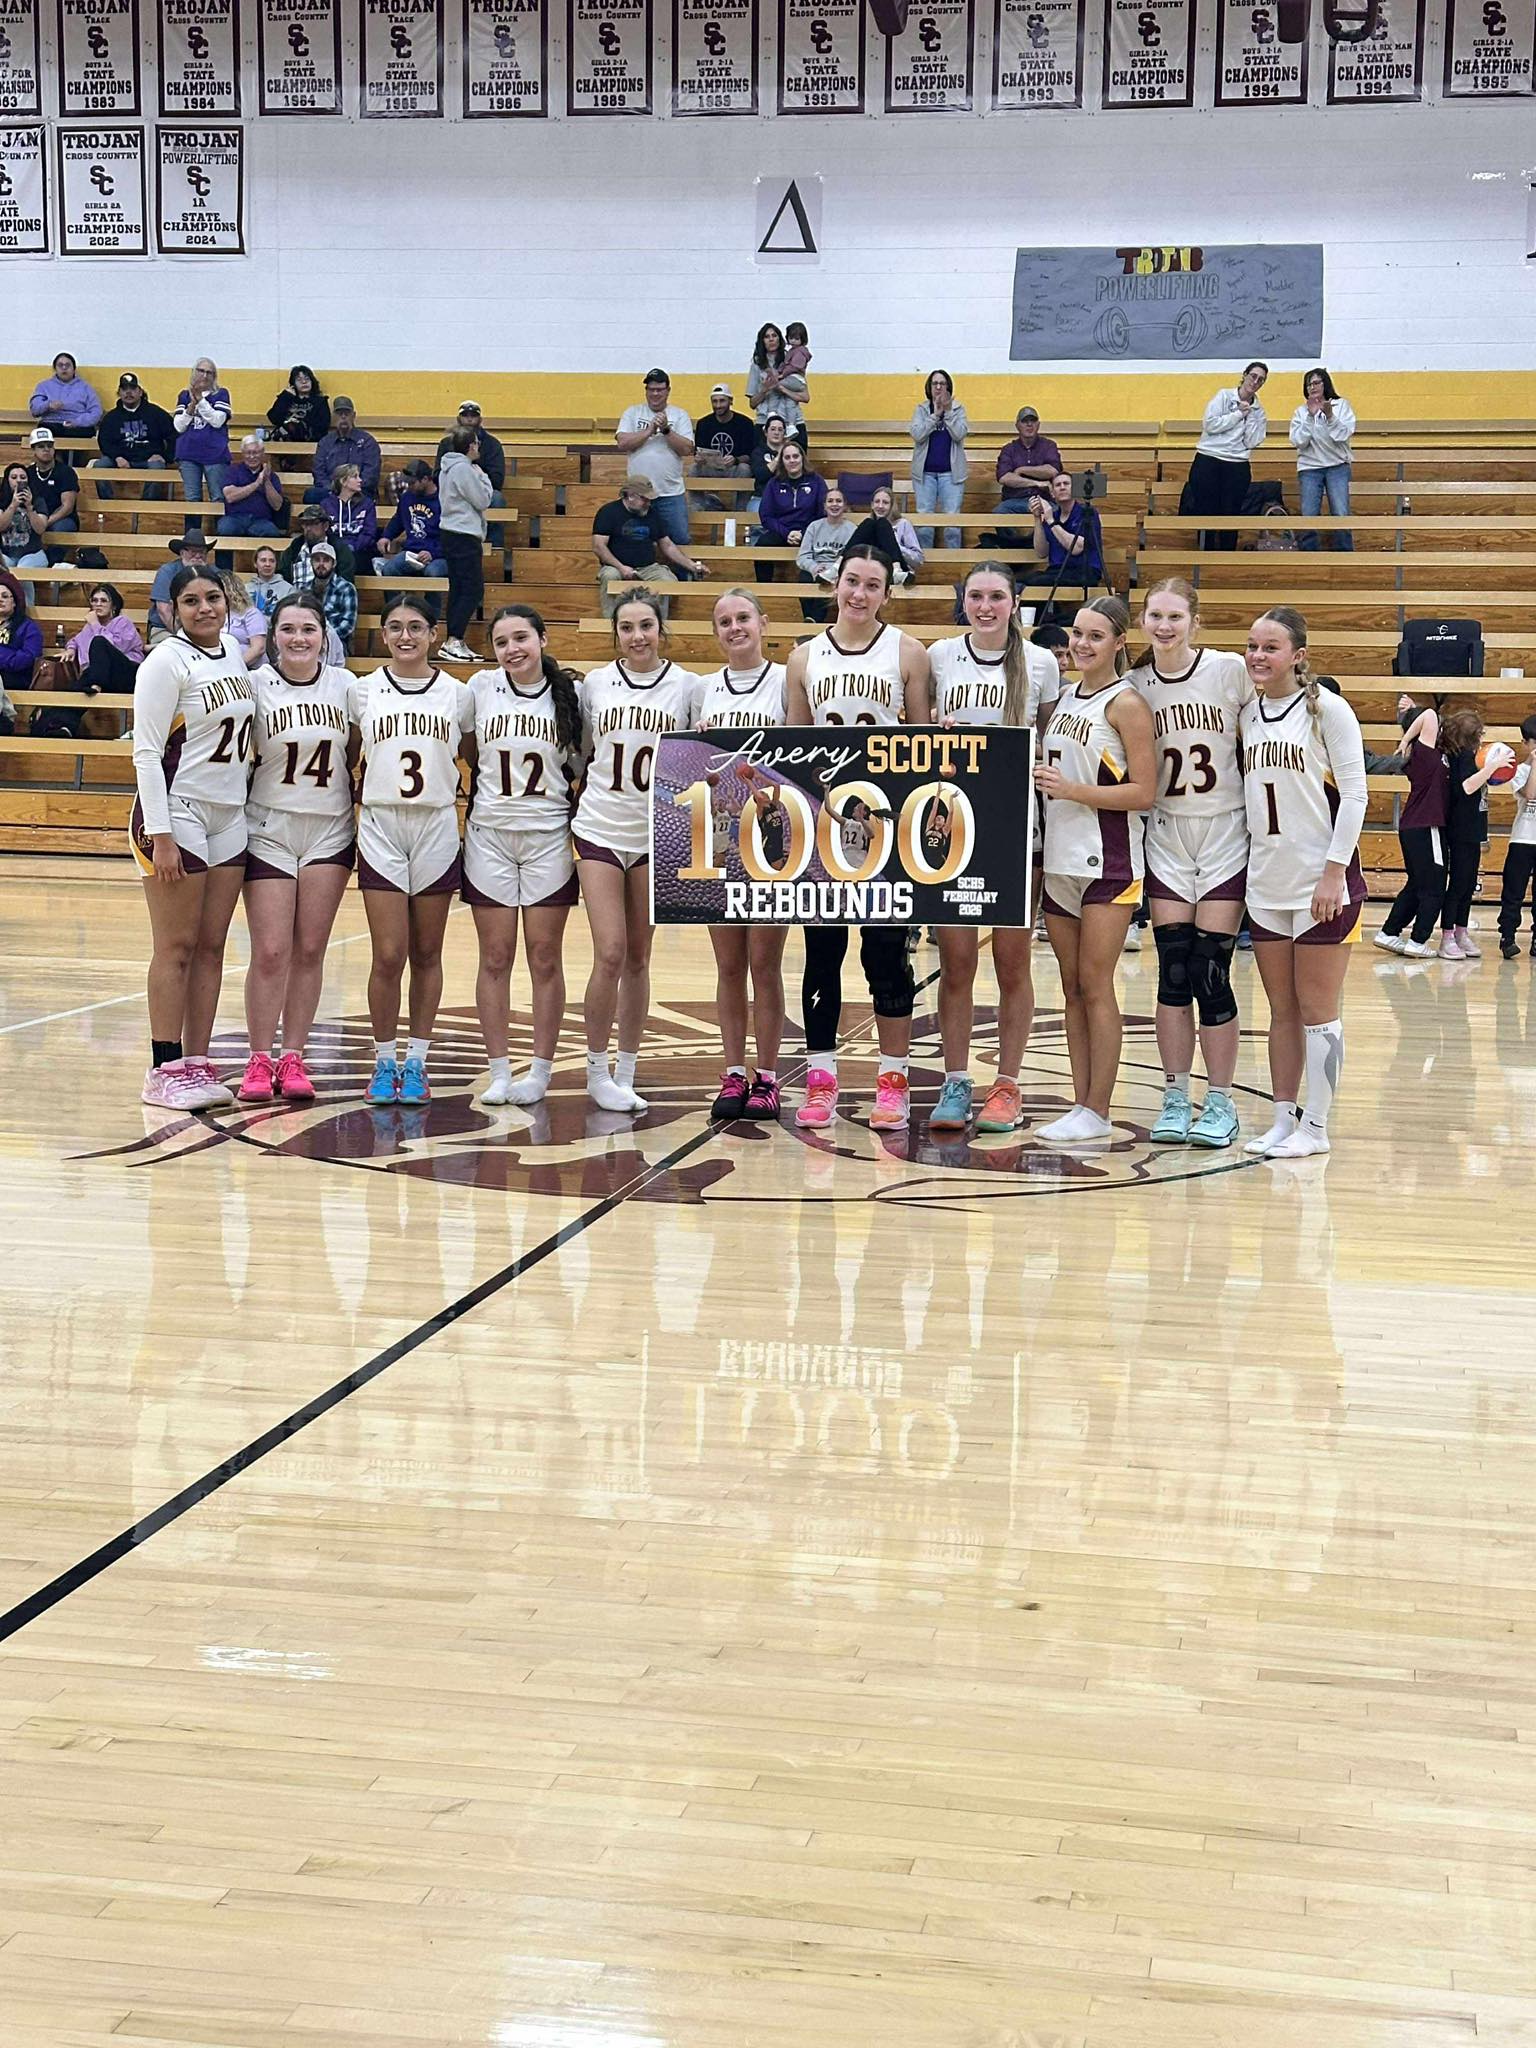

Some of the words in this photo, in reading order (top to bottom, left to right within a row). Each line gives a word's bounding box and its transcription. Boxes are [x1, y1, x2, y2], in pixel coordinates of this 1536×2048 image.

[65, 0, 130, 14] TROJAN
[165, 0, 231, 14] TROJAN
[369, 0, 435, 13] TROJAN
[473, 0, 538, 13] TROJAN
[927, 6, 963, 14] COUNTRY
[1005, 3, 1031, 11] CROSS
[1034, 2, 1072, 11] COUNTRY
[85, 16, 111, 24] TRACK
[167, 16, 193, 24] CROSS
[195, 16, 228, 24] COUNTRY
[267, 13, 293, 21] CROSS
[295, 13, 328, 21] COUNTRY
[388, 15, 415, 23] TRACK
[492, 14, 518, 23] TRACK
[578, 11, 603, 20] CROSS
[606, 11, 641, 19] COUNTRY
[683, 11, 708, 20] CROSS
[711, 11, 747, 19] COUNTRY
[789, 9, 815, 18] CROSS
[818, 9, 855, 17] COUNTRY
[1357, 53, 1393, 63] STATE
[1475, 47, 1511, 58] STATE
[1020, 60, 1055, 70] STATE
[1131, 58, 1166, 68] STATE
[1244, 55, 1280, 66] STATE
[1454, 59, 1530, 75] CHAMPIONS
[83, 70, 115, 79] STATE
[184, 70, 215, 80] STATE
[283, 68, 315, 77] STATE
[385, 70, 418, 80] STATE
[489, 70, 521, 79] STATE
[593, 67, 626, 77] STATE
[699, 67, 731, 77] STATE
[804, 65, 838, 75] STATE
[912, 64, 947, 73] STATE
[1225, 67, 1299, 83] CHAMPIONS
[1337, 64, 1412, 80] CHAMPIONS
[895, 75, 965, 90] CHAMPIONS
[1001, 71, 1073, 87] CHAMPIONS
[1112, 69, 1184, 86] CHAMPIONS
[67, 81, 132, 95] CHAMPIONS
[166, 81, 232, 96] CHAMPIONS
[267, 79, 333, 93] CHAMPIONS
[368, 81, 435, 96] CHAMPIONS
[472, 81, 539, 96] CHAMPIONS
[576, 78, 644, 93] CHAMPIONS
[681, 78, 749, 94] CHAMPIONS
[786, 77, 856, 92] CHAMPIONS
[1244, 84, 1280, 97] 1994
[1356, 82, 1392, 95] 1994
[912, 92, 946, 104] 1992
[1020, 88, 1054, 101] 1993
[1130, 87, 1165, 99] 1994
[84, 97, 116, 108] 1983
[183, 97, 215, 109] 1984
[489, 97, 521, 109] 1986
[593, 95, 626, 107] 1989
[63, 134, 140, 149] TROJAN
[161, 133, 238, 148] TROJAN
[65, 152, 94, 160] CROSS
[96, 152, 139, 160] COUNTRY
[163, 153, 238, 165] POWERLIFTING
[90, 165, 114, 196] SC
[187, 166, 210, 196] SC
[193, 198, 206, 207] 1A
[83, 213, 124, 222] STATE
[181, 213, 221, 221] STATE
[67, 225, 141, 234] CHAMPIONS
[163, 222, 236, 232] CHAMPIONS
[89, 237, 119, 246] 2022
[186, 235, 216, 245] 2024
[1096, 273, 1220, 302] POWERLIFTING
[201, 679, 229, 715] LADY
[812, 674, 838, 710] LADY
[842, 673, 892, 708] TROJANS
[944, 684, 972, 716] LADY
[975, 683, 1004, 709] TROJ
[266, 706, 293, 740] LADY
[297, 703, 346, 735] TROJANS
[598, 706, 625, 737] LADY
[1172, 703, 1225, 735] TROJANS
[373, 713, 400, 744] LADY
[404, 712, 451, 744] TROJANS
[484, 714, 511, 744] LADY
[1054, 712, 1094, 747] TROJANS
[207, 714, 253, 763] 20
[705, 730, 862, 782] Avery
[867, 735, 987, 774] SCOTT
[1261, 741, 1305, 774] TROJANS
[280, 740, 334, 788] 14
[609, 741, 652, 793] 10
[1163, 743, 1217, 797] 23
[400, 750, 424, 799] 3
[496, 749, 547, 797] 12
[1262, 782, 1281, 836] 1
[674, 780, 976, 885] 1000
[845, 831, 857, 845] 22
[928, 837, 939, 847] 22
[958, 877, 985, 889] SCHS
[724, 881, 914, 919] REBOUNDS
[943, 890, 998, 903] FEBRUARY
